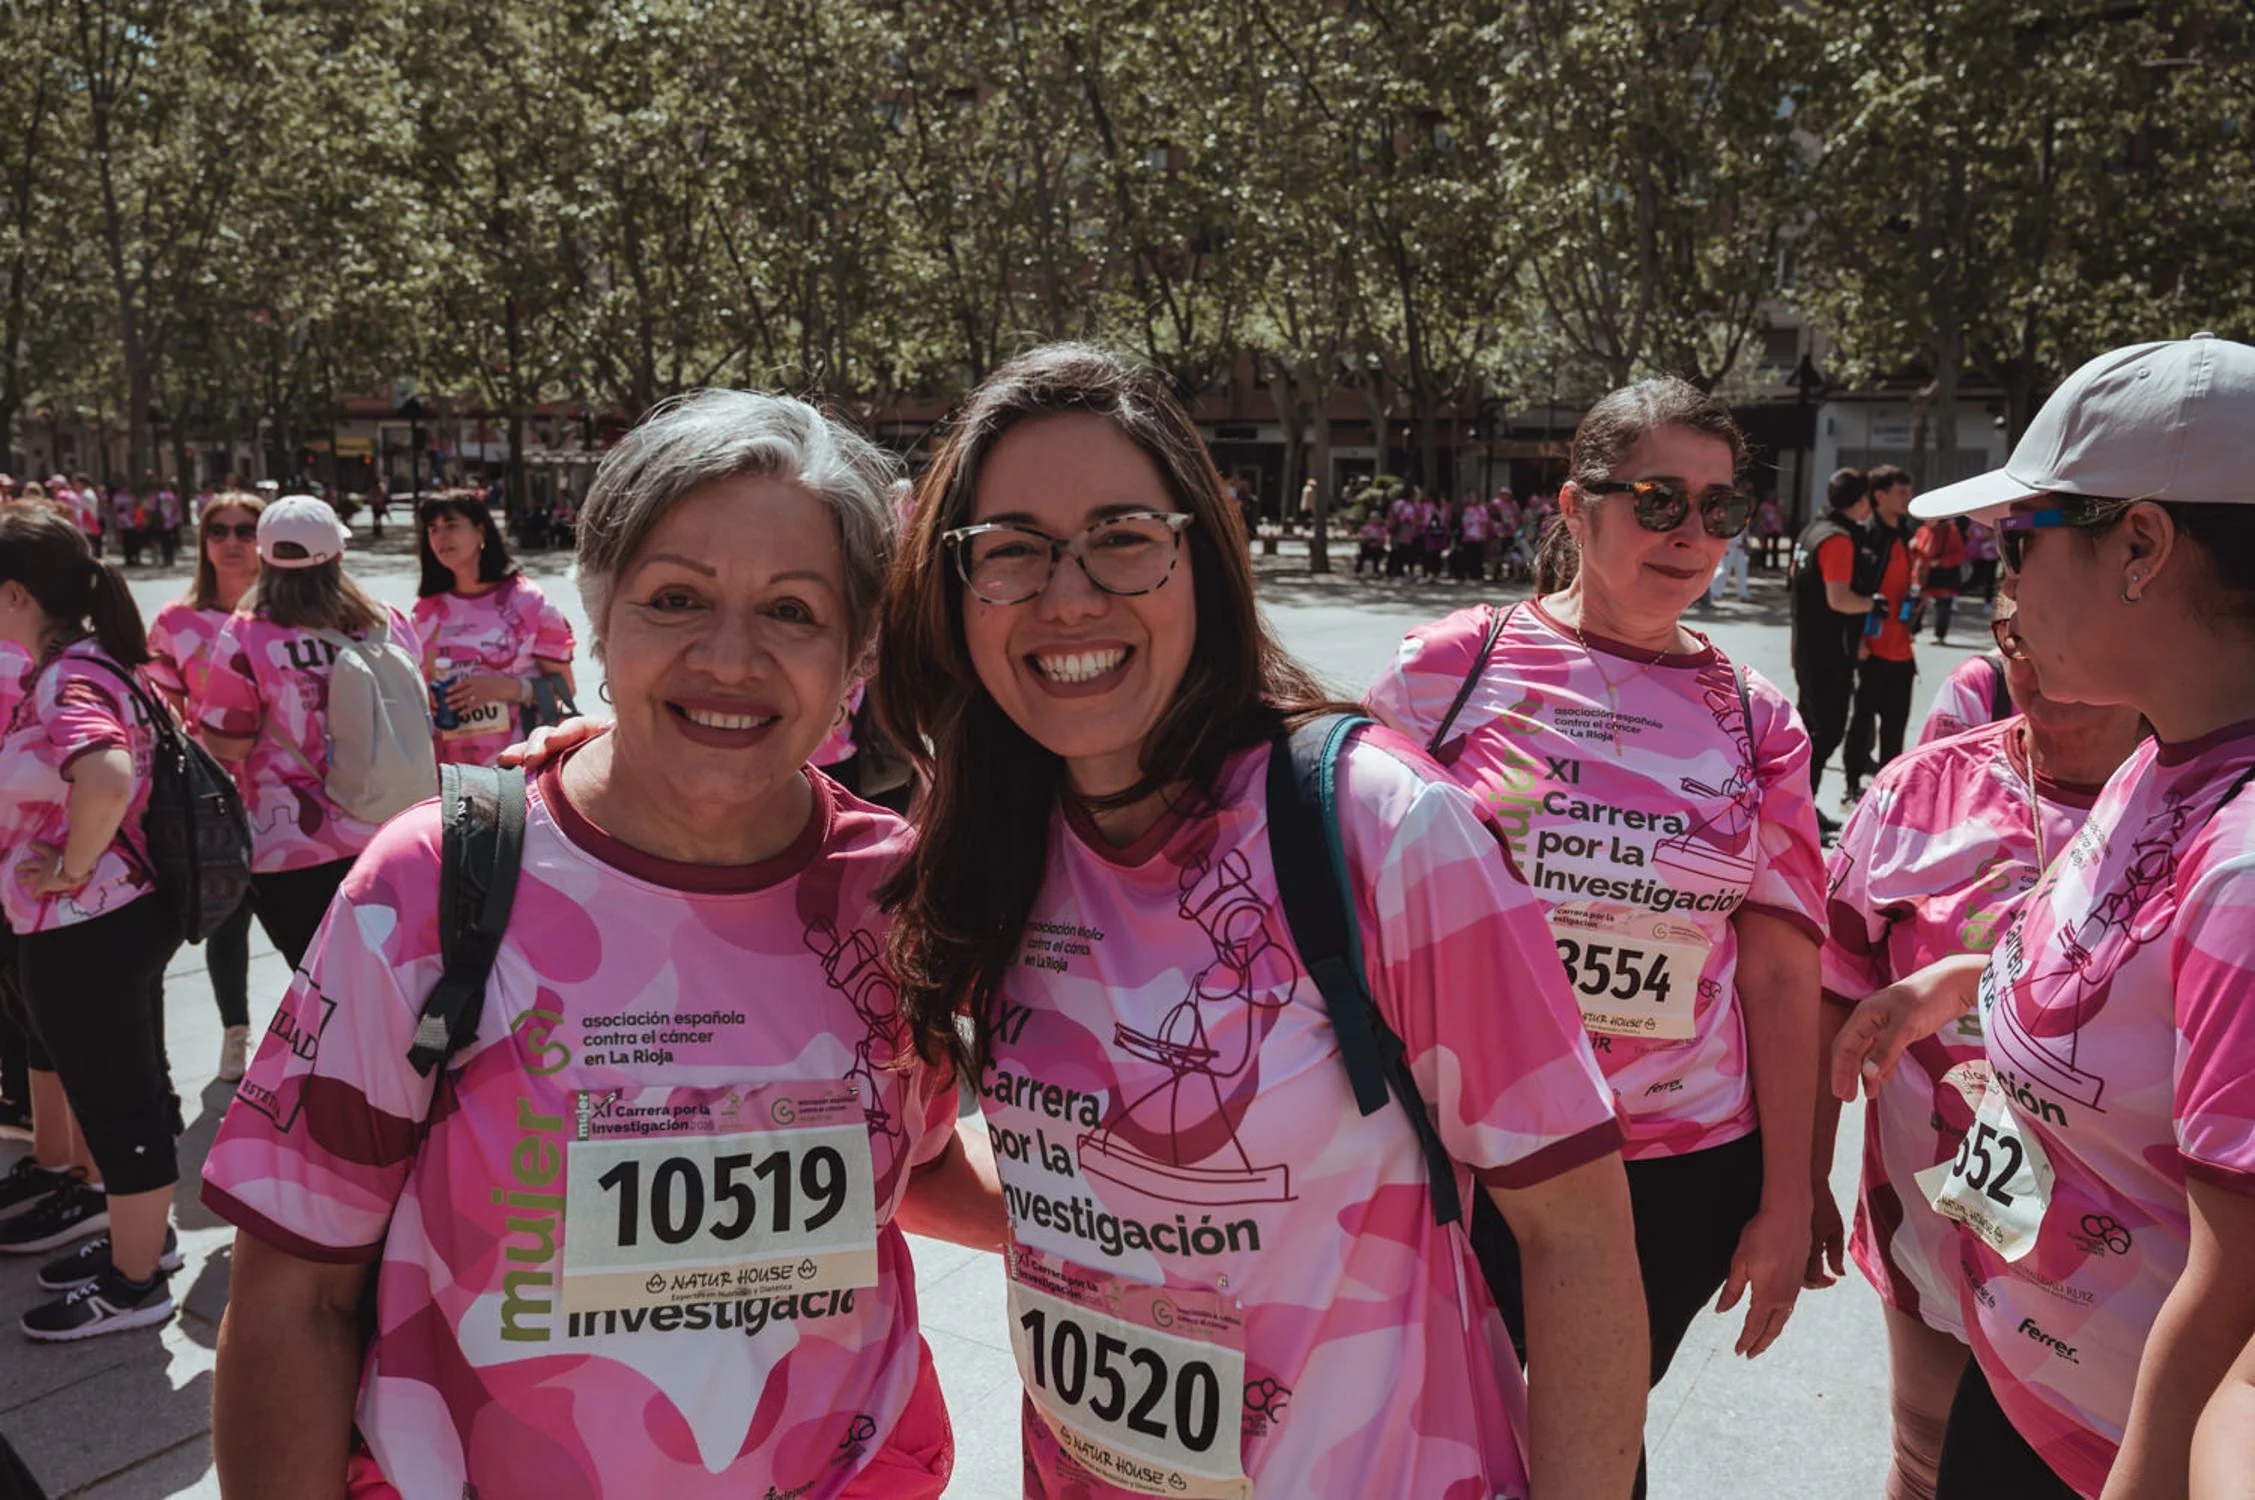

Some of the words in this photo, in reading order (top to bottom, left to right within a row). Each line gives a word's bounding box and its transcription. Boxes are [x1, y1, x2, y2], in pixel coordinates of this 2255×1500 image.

[1554, 706, 1615, 719] asociación
[1616, 711, 1664, 730] española
[1554, 717, 1591, 729] contra
[1592, 720, 1602, 730] el
[1603, 721, 1642, 735] cáncer
[1569, 728, 1584, 739] La
[1586, 730, 1614, 743] Rioja
[1545, 756, 1580, 785] XI
[1542, 791, 1687, 837] Carrera
[1537, 829, 1603, 859] por
[1610, 836, 1645, 868] la
[582, 1010, 670, 1029] asociación
[674, 1009, 746, 1028] española
[583, 1030, 638, 1047] contra
[641, 1029, 657, 1045] el
[659, 1028, 715, 1044] cáncer
[992, 1000, 1032, 1045] XI
[584, 1052, 605, 1066] en
[609, 1050, 630, 1065] La
[633, 1048, 674, 1067] Rioja
[592, 1100, 612, 1119] XI
[615, 1104, 670, 1118] Carrera
[672, 1104, 697, 1120] por
[697, 1103, 711, 1116] la
[979, 1059, 1101, 1130] Carrera
[575, 1093, 591, 1138] mujer
[592, 1118, 690, 1136] Investigación
[1036, 1128, 1075, 1178] la
[598, 1144, 848, 1248] 10519
[491, 1096, 567, 1343] mujer
[1002, 1180, 1261, 1257] nvestigación
[671, 1271, 733, 1291] NATUR
[736, 1264, 794, 1286] HOUSE
[2017, 1317, 2078, 1357] Ferrer
[1020, 1307, 1221, 1453] 10520
[1073, 1442, 1113, 1468] NATUR
[1115, 1455, 1165, 1486] HOUSE
